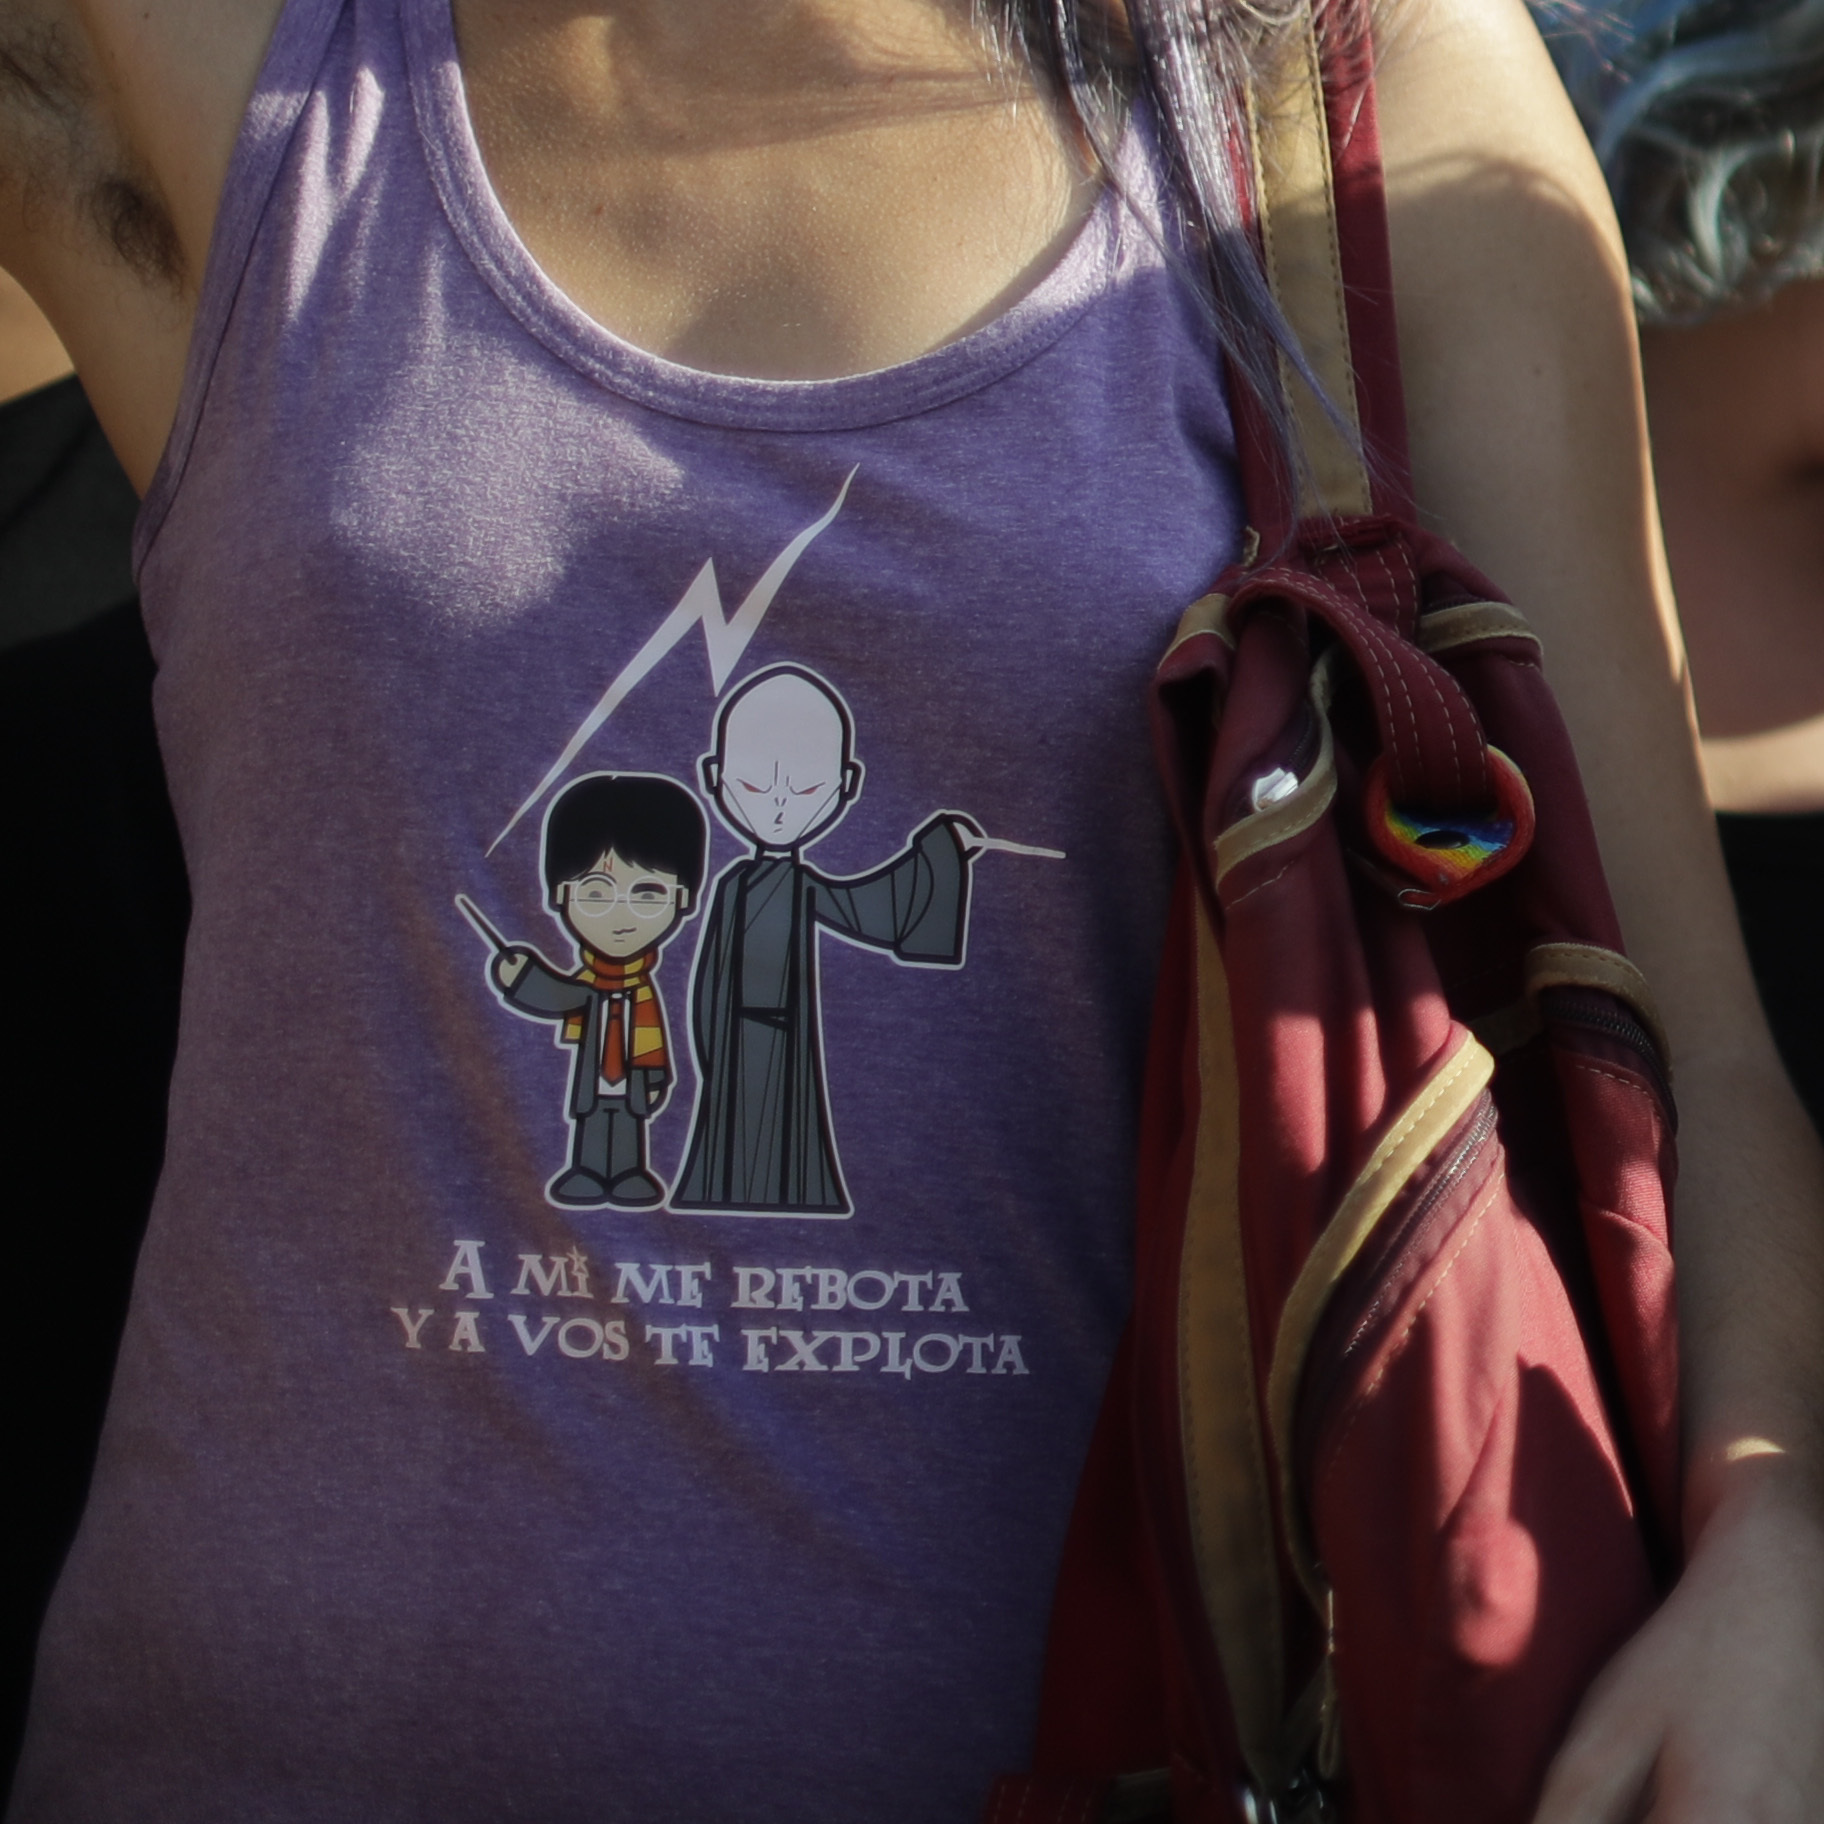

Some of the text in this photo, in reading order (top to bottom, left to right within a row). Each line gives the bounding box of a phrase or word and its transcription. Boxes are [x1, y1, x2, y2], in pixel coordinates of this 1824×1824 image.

[438, 1239, 495, 1300] A
[609, 1262, 712, 1310] ME
[730, 1267, 970, 1313] REBOTA
[390, 1308, 1031, 1381] Y A VOS TE EXPLOTA
